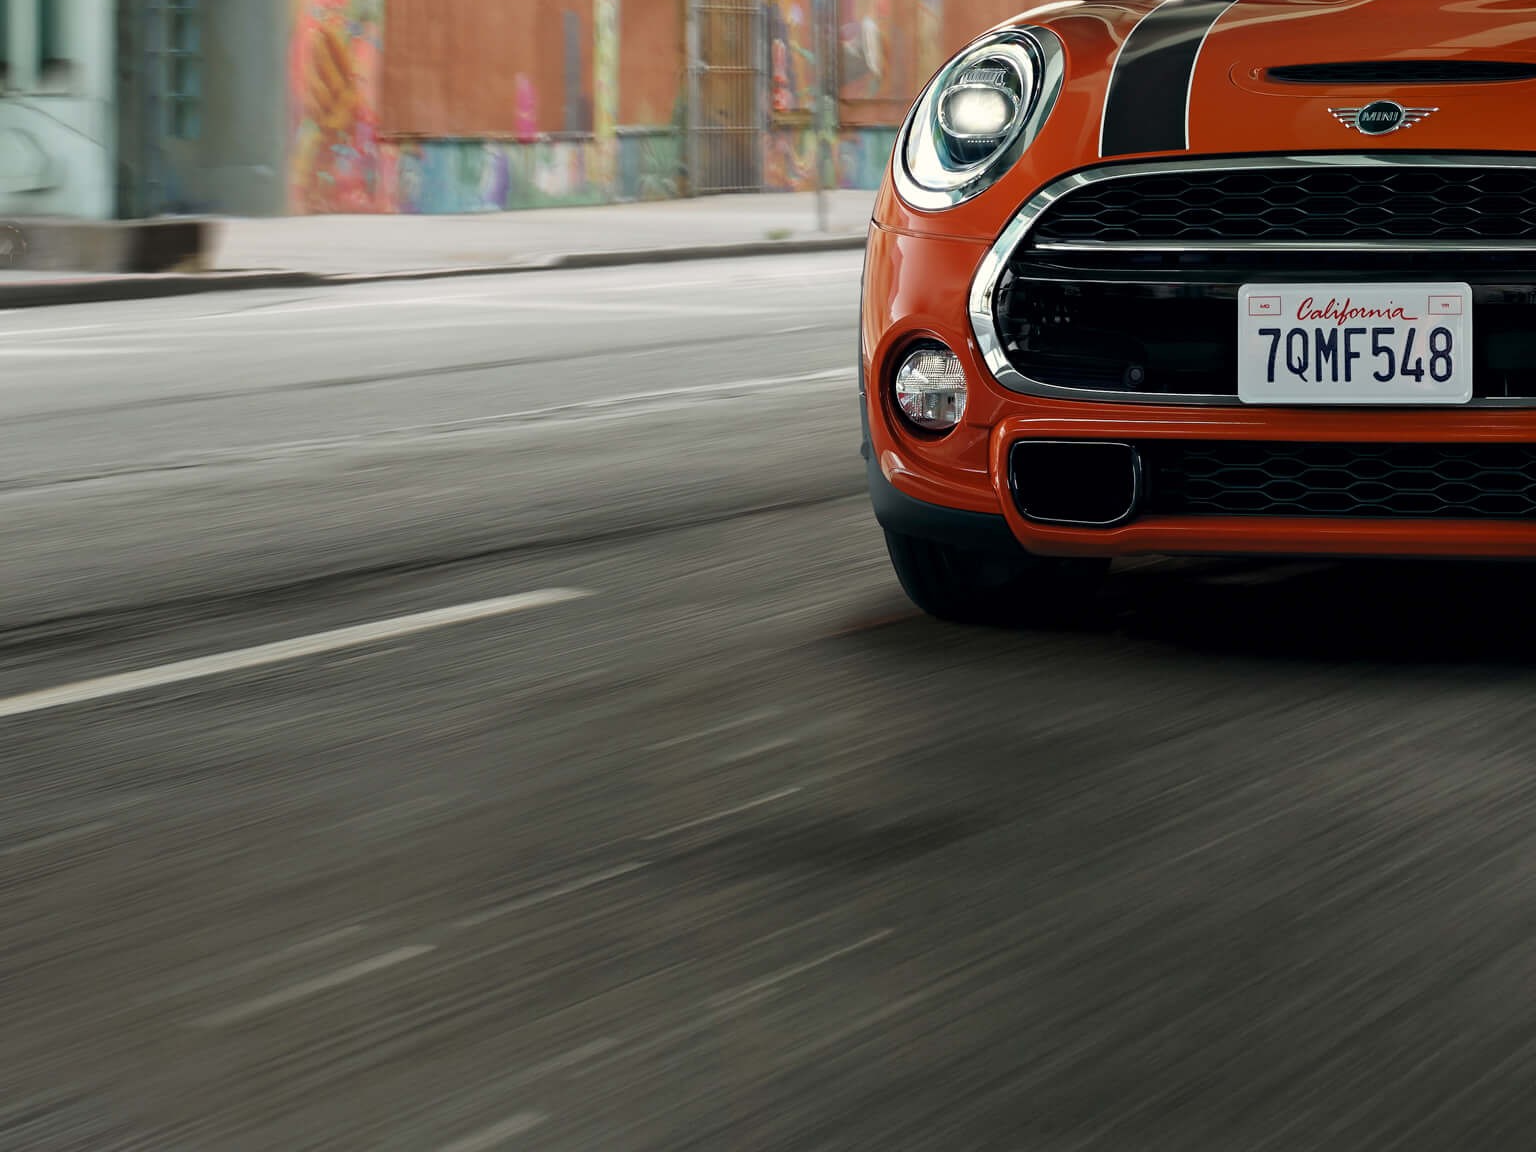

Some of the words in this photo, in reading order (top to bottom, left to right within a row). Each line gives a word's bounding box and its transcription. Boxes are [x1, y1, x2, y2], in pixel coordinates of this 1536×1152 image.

[1361, 111, 1399, 121] MINI
[1296, 297, 1418, 326] California
[1258, 326, 1453, 383] 7QMF548
